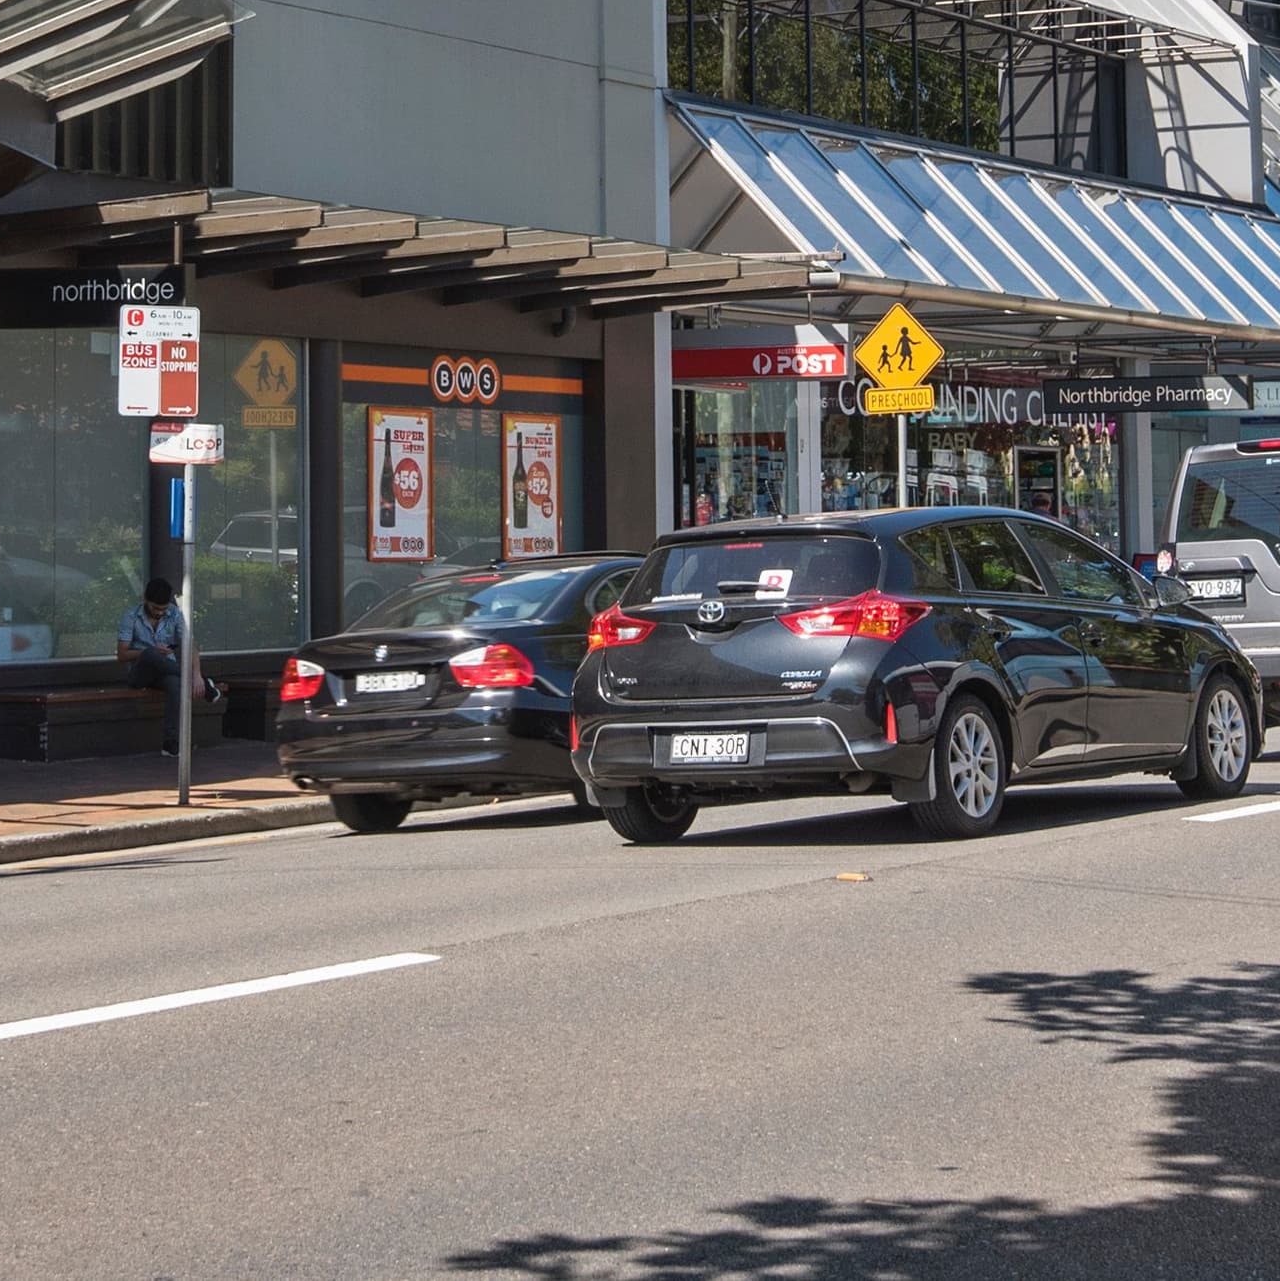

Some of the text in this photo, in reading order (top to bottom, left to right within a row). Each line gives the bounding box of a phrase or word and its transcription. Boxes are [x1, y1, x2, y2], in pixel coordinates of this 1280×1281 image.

[52, 278, 174, 304] northbridge
[126, 345, 152, 356] BUS
[171, 347, 187, 359] NO
[777, 347, 807, 355] AUSTRALIA
[122, 357, 156, 368] ZONE
[161, 361, 197, 373] STOPPING
[777, 353, 837, 374] POST
[440, 370, 492, 389] BWS
[872, 392, 930, 408] PRESCHOOL
[1059, 386, 1151, 406] Northbridge
[1156, 385, 1233, 405] Pharmacy
[393, 429, 424, 441] SUPER
[927, 431, 977, 451] BABY
[395, 471, 419, 490] $56
[528, 478, 548, 495] $52
